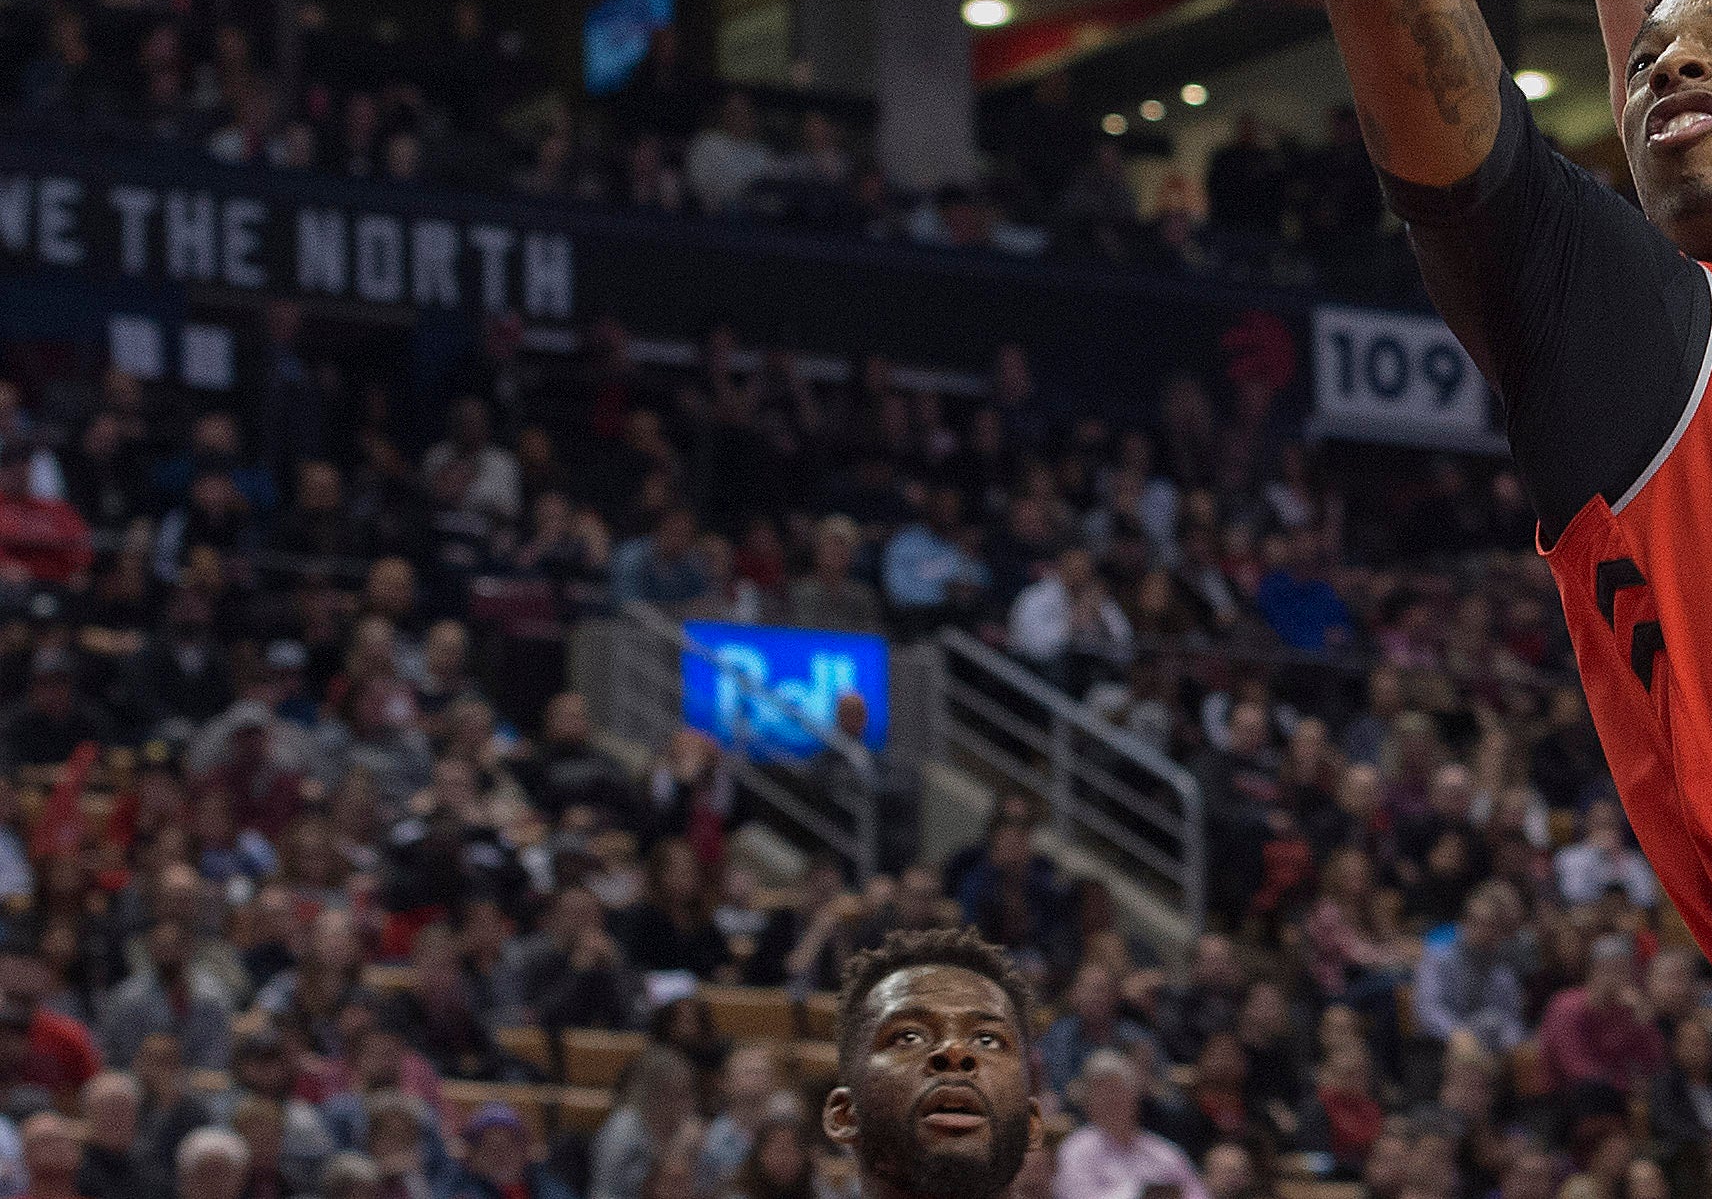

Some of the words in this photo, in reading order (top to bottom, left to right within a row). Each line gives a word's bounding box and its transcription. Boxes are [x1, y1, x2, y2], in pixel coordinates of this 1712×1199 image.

[109, 186, 268, 288] THE
[298, 206, 574, 319] NORTH
[1329, 328, 1465, 408] 109
